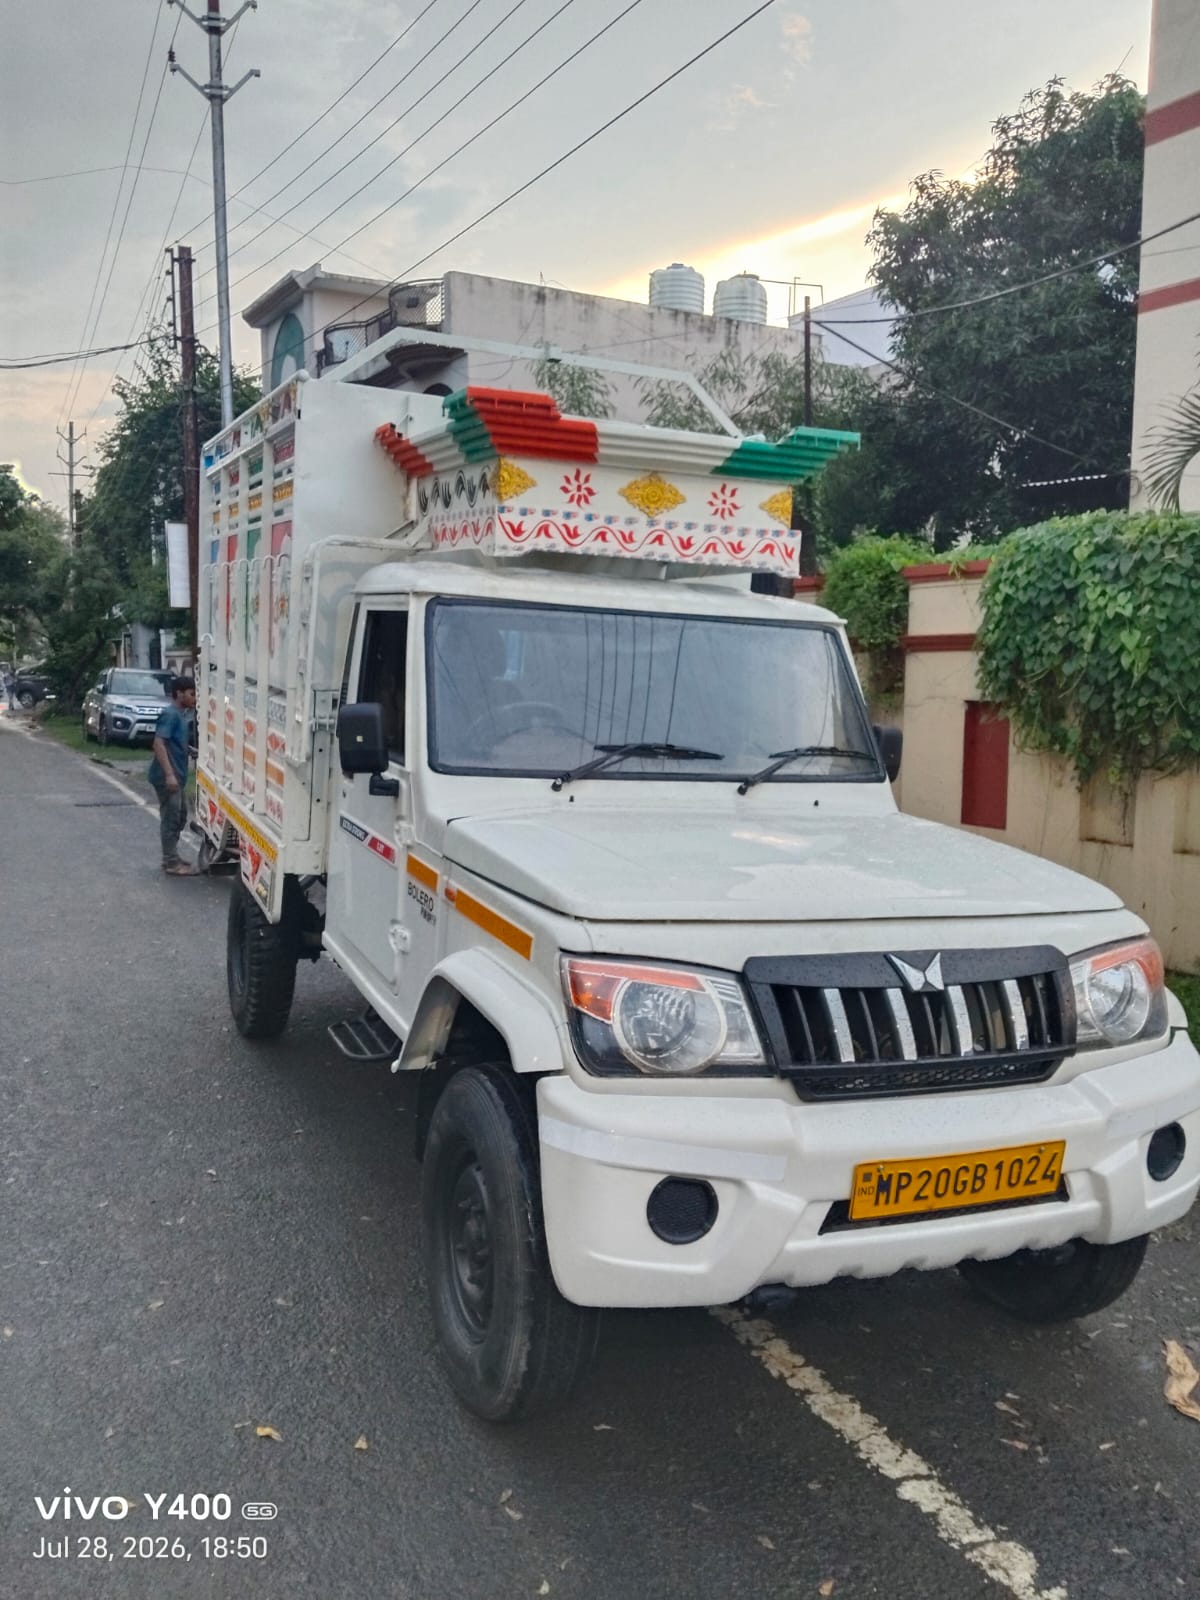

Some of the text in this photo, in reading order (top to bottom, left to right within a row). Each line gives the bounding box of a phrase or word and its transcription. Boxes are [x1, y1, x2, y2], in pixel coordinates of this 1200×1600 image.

[407, 881, 434, 912] BOLERO
[857, 1185, 874, 1197] IND
[874, 1151, 1060, 1207] MP20GB1024
